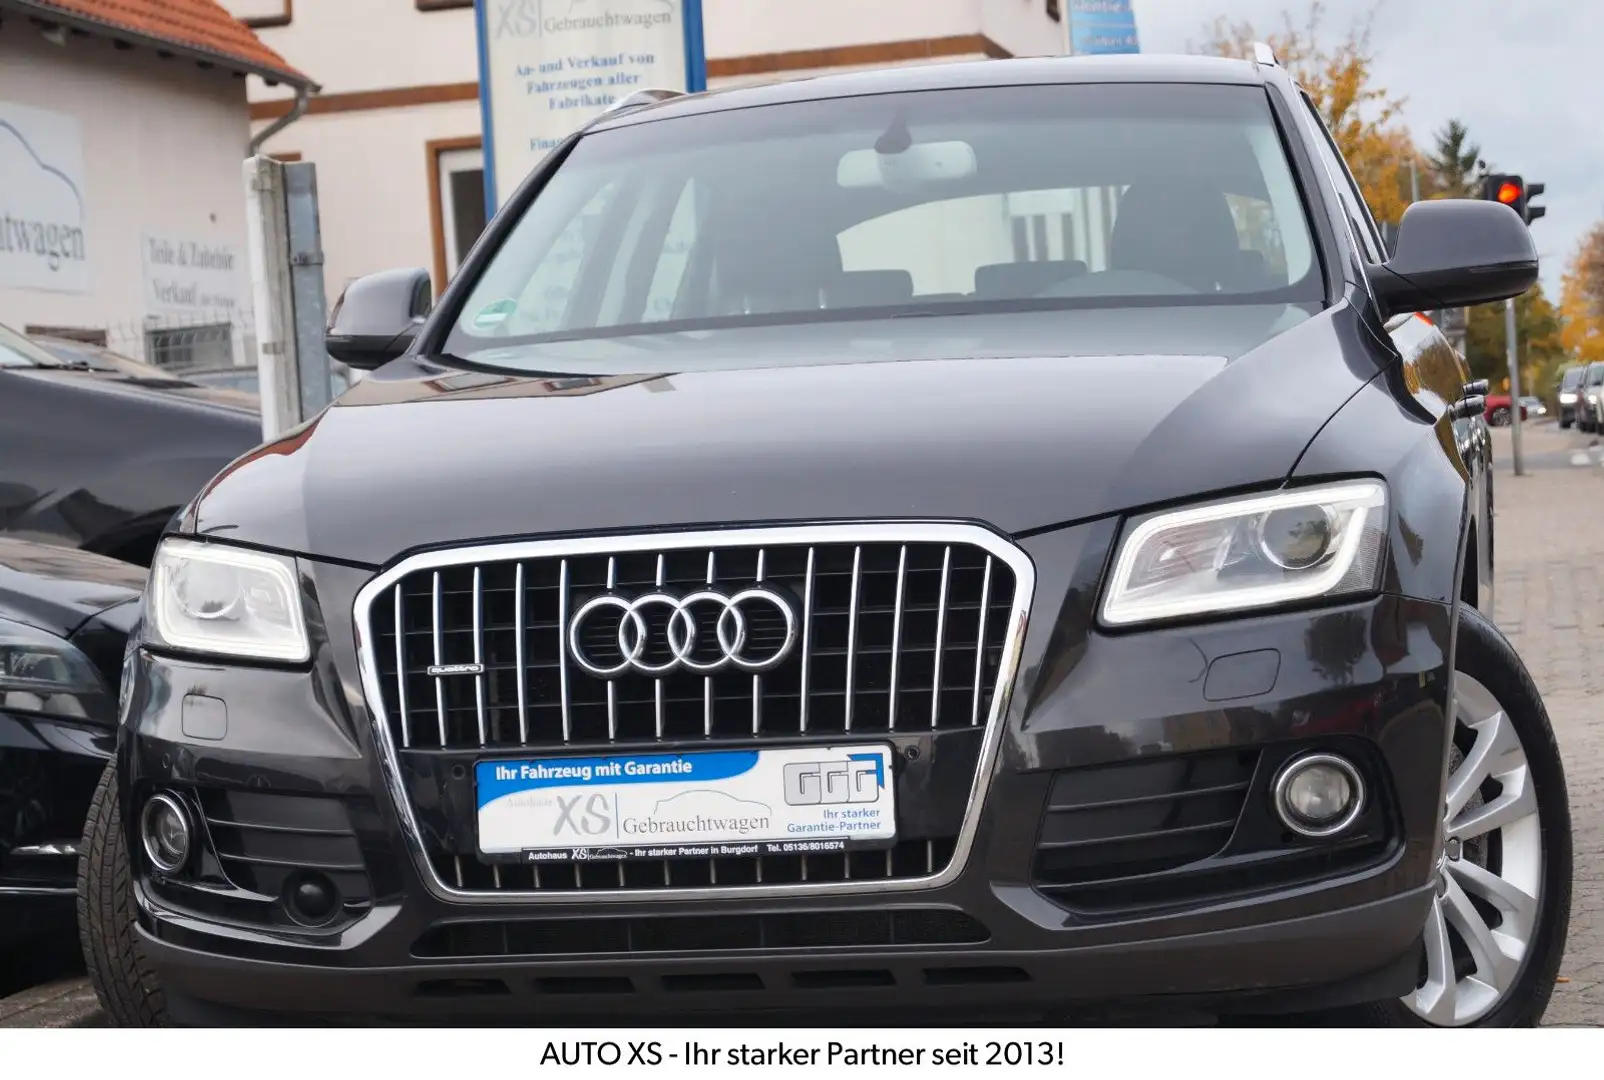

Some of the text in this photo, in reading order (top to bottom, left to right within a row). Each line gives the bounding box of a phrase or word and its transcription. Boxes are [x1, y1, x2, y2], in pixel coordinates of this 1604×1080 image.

[544, 10, 672, 34] Gebrauchtwagen
[539, 59, 563, 74] und
[567, 54, 624, 70] Verkauf
[629, 52, 655, 65] von
[527, 73, 641, 95] Fahrzeugen aller
[0, 212, 85, 272] twagen
[496, 759, 693, 780] Ihr Fahrzeug mit Garantie
[553, 792, 611, 836] XS
[823, 808, 880, 819] Ihr starker
[623, 815, 769, 834] Gebrauchtwagen
[787, 821, 881, 833] Garantie-Partner
[528, 851, 568, 860] Autohaus
[571, 848, 588, 860] XS
[635, 848, 646, 857] Ihr
[648, 847, 677, 857] starker
[679, 845, 709, 857] Partner
[711, 845, 719, 853] in
[721, 845, 758, 856] Burgdorf
[767, 843, 782, 853] Tel.
